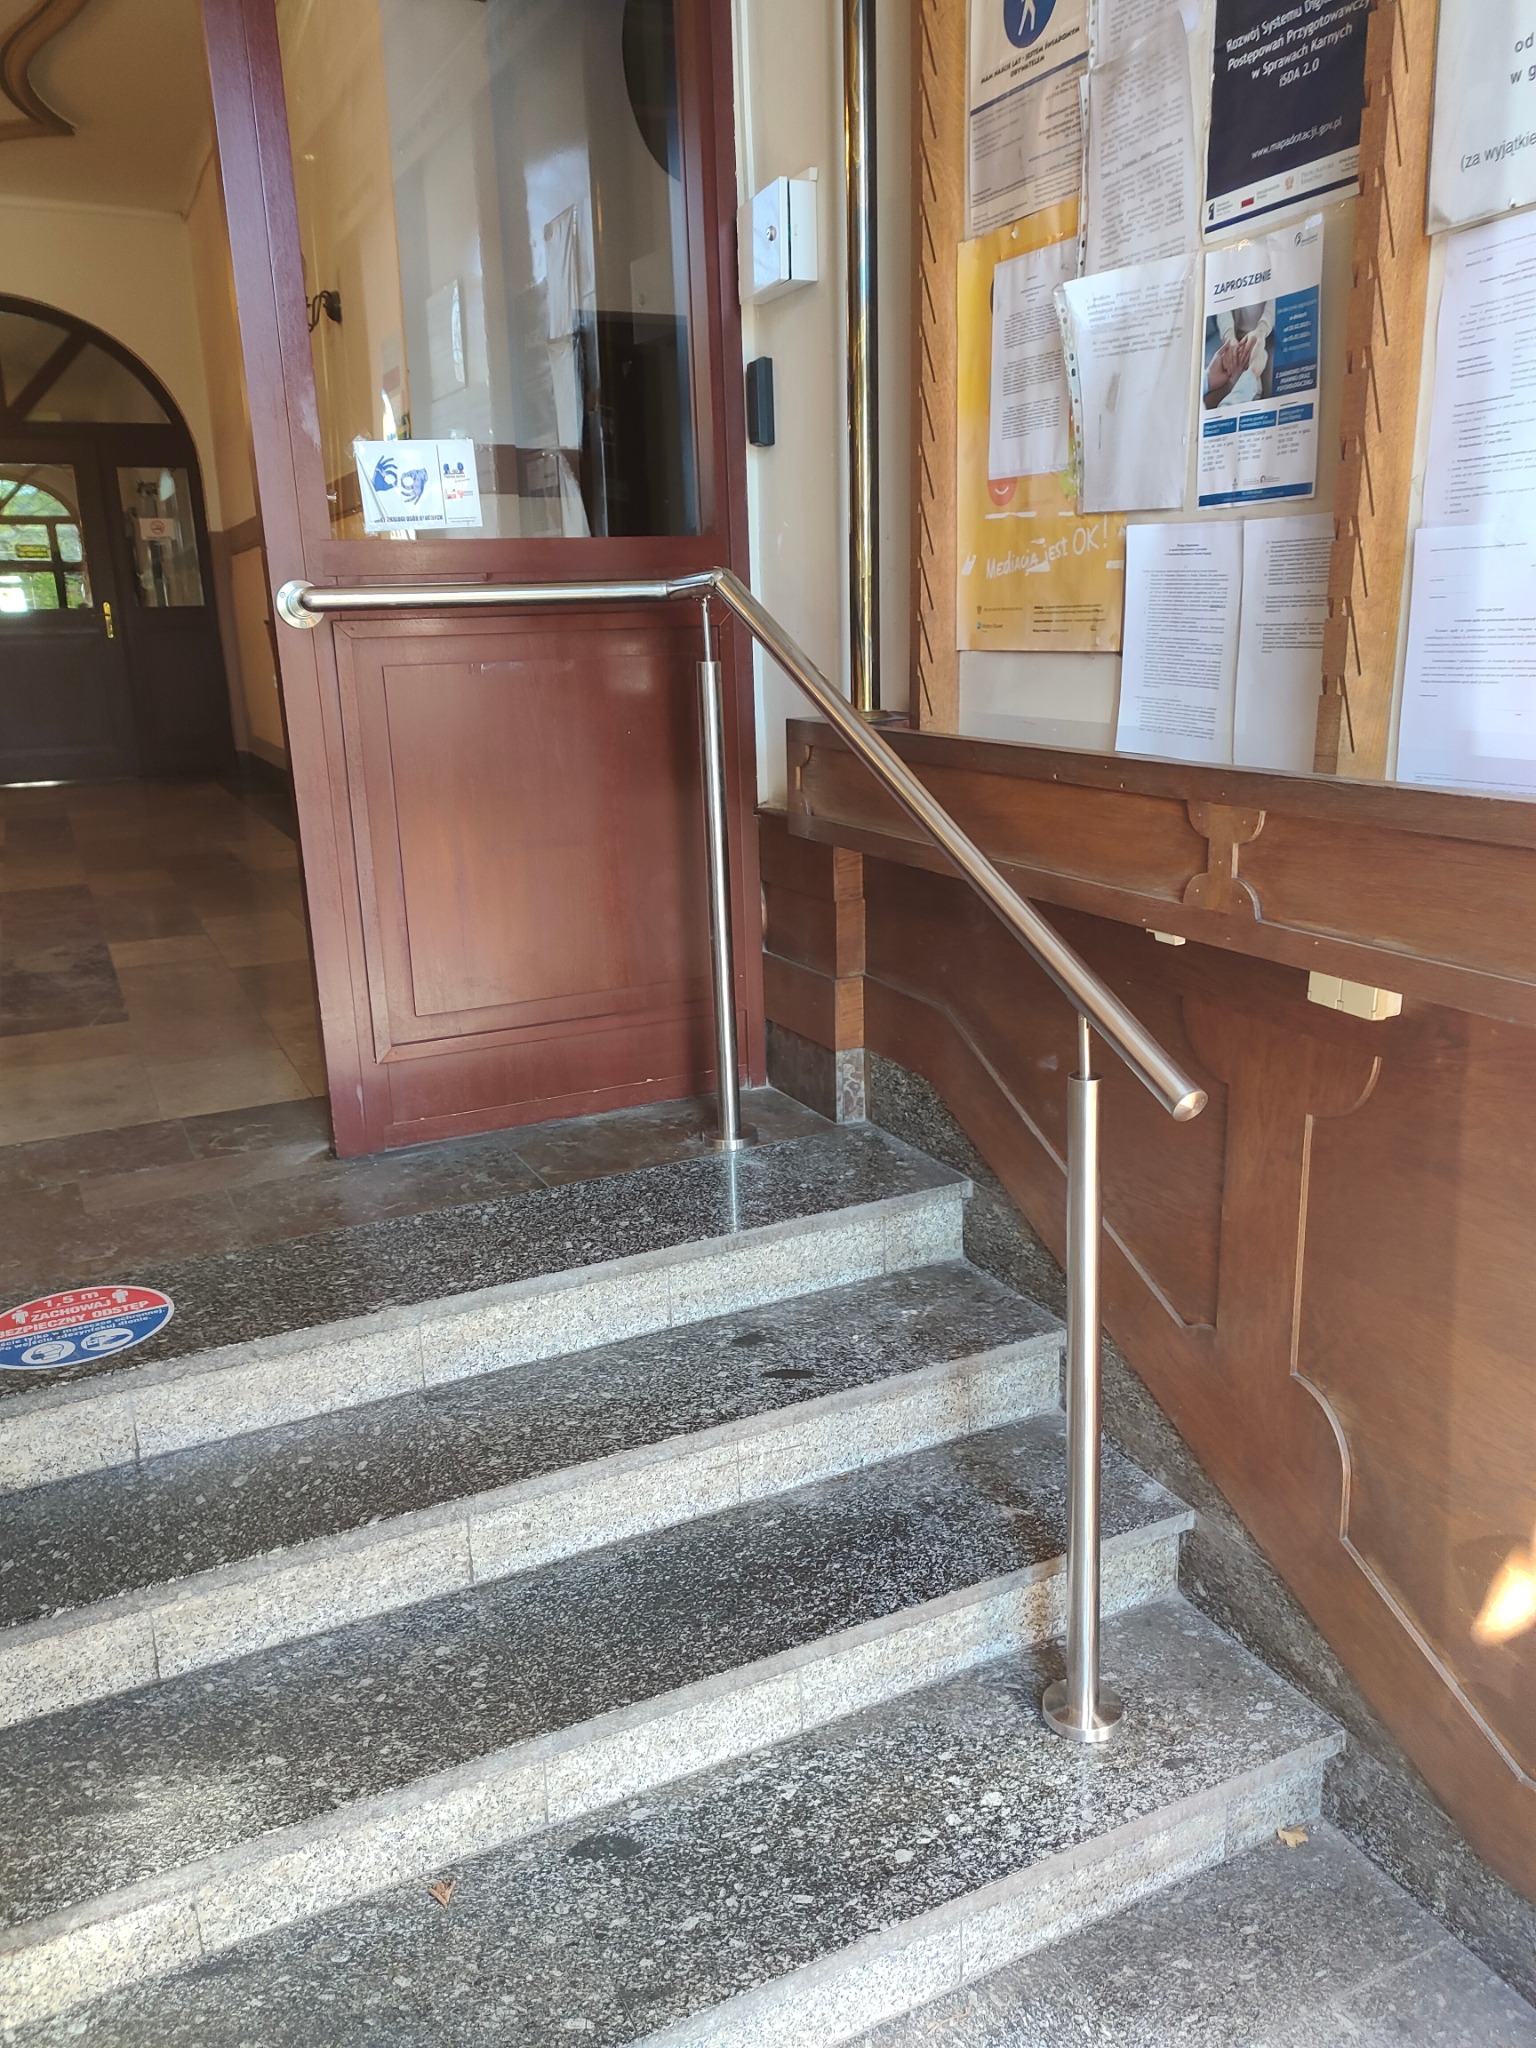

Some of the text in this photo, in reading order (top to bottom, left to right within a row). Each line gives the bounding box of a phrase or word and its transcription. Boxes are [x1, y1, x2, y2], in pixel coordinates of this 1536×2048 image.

[1226, 24, 1261, 53] Rozwój
[1261, 5, 1302, 36] Systemu
[1227, 33, 1285, 72] Postępowań
[1251, 22, 1353, 80] w Sprawach Karnych
[1514, 32, 1535, 53] od
[1302, 57, 1320, 77] 2.0
[1510, 69, 1523, 85] w
[1251, 115, 1343, 160] www.mapadotacji.gov.pl
[1460, 154, 1481, 172] (za
[1213, 268, 1272, 296] ZAPROSZENIE
[31, 1299, 112, 1322] ZACHOWAJ
[43, 1291, 99, 1308] 1,5 m
[92, 1300, 150, 1318] ODSTĘP
[14, 1337, 53, 1347] wejściu
[56, 1323, 116, 1340] zdezynfekuj
[24, 1333, 50, 1343] tylko
[114, 1308, 166, 1322] ochronnej.
